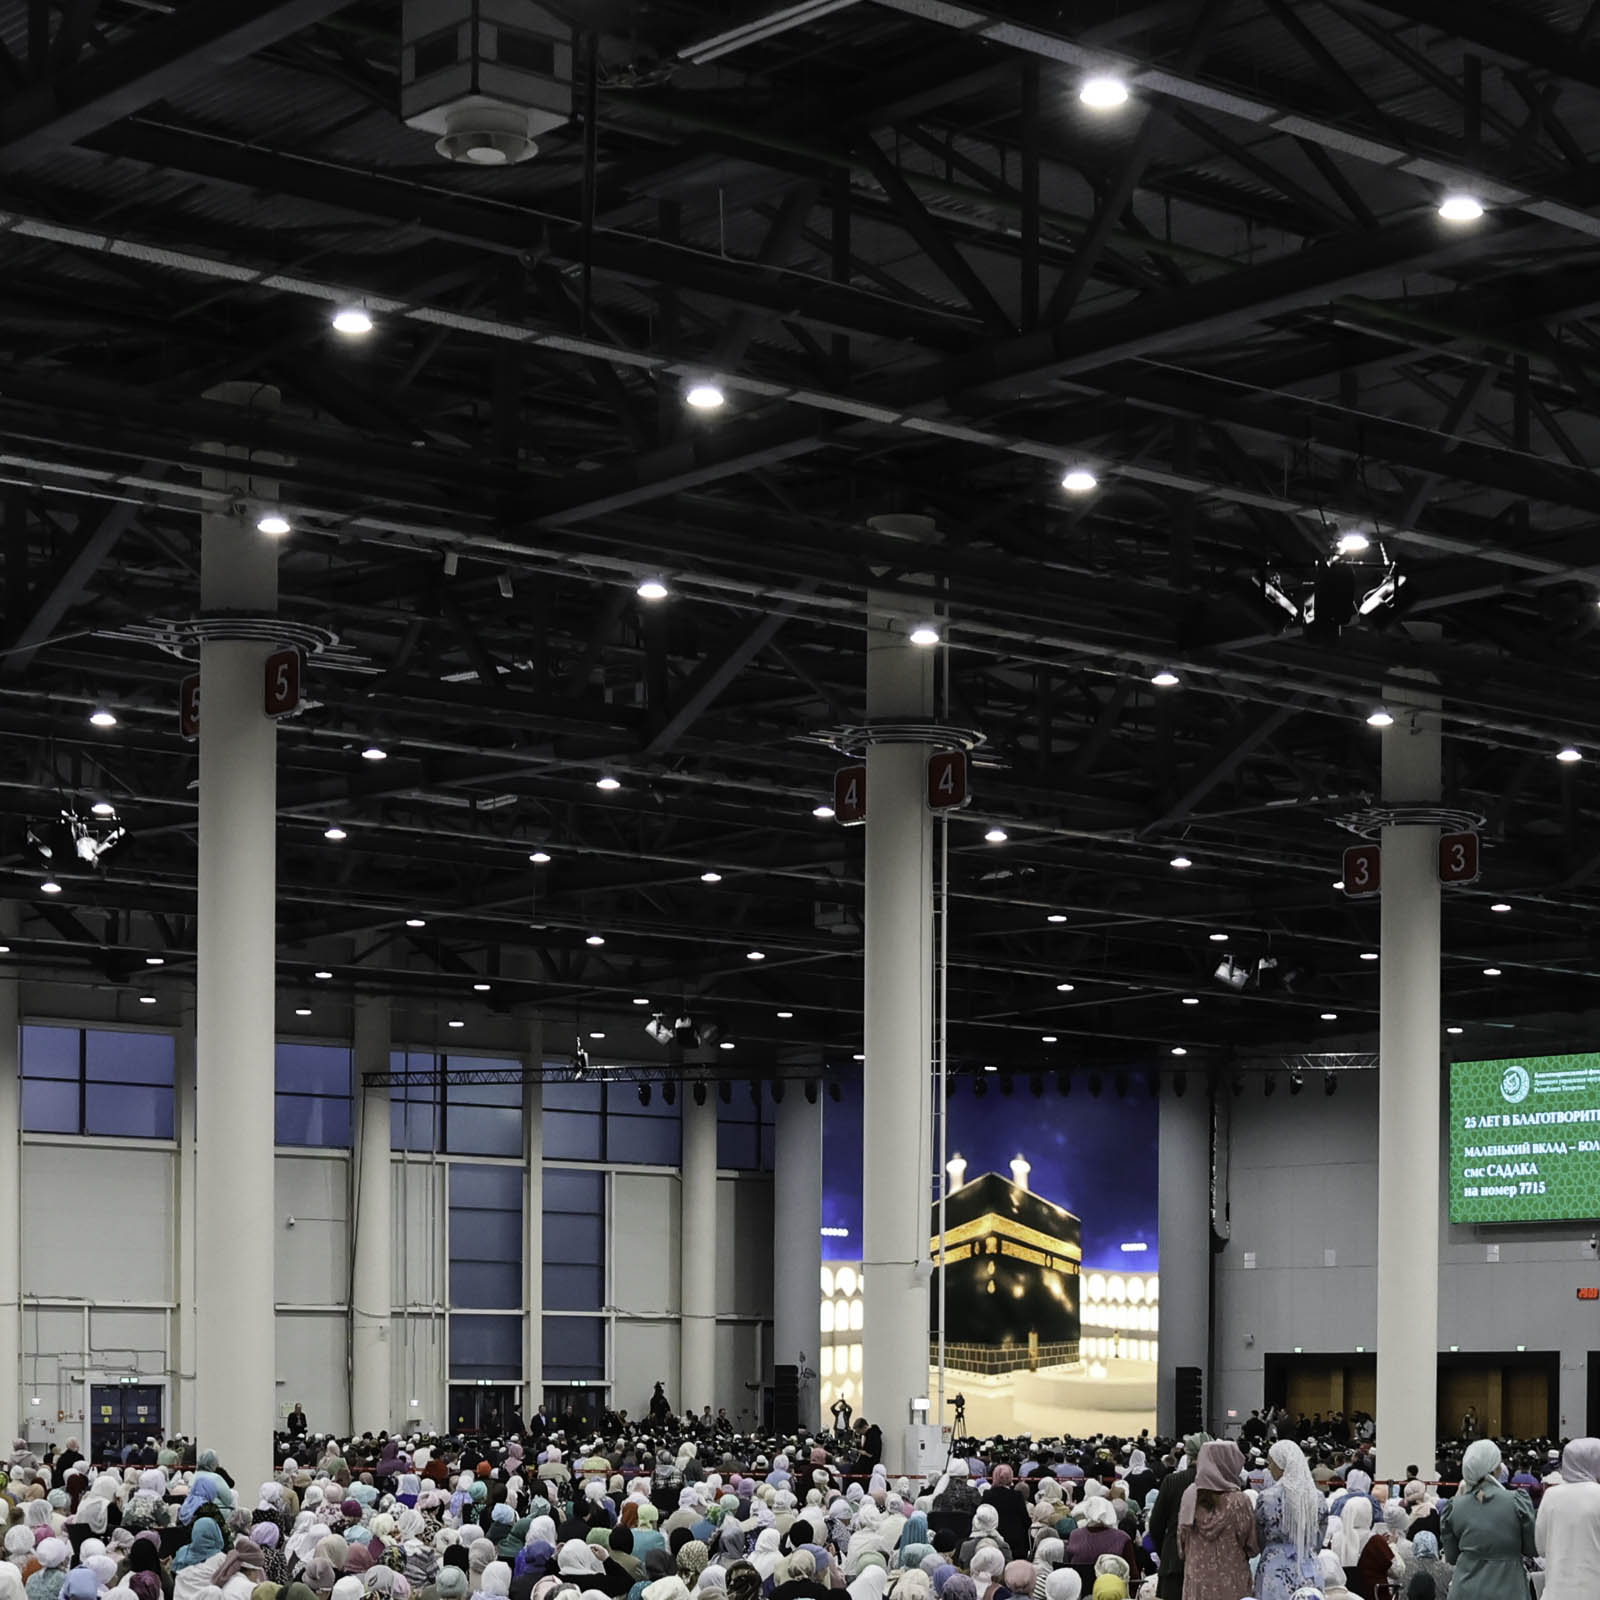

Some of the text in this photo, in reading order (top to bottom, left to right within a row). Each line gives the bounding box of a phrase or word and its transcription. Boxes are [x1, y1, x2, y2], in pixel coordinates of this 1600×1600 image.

[274, 663, 288, 701] 5
[938, 763, 954, 795] 4
[844, 778, 858, 809] 4
[1354, 857, 1369, 885] 3
[1450, 844, 1465, 872] 3
[1464, 1116, 1477, 1129] 25
[1478, 1115, 1500, 1128] ЛЕТ
[1502, 1114, 1511, 1127] В
[1464, 1142, 1531, 1157] МАЛЕНЬКИЙ
[1532, 1142, 1568, 1156] ВКЛАД
[1464, 1162, 1539, 1179] смс САДАКА
[1464, 1182, 1546, 1198] на номер 7715
